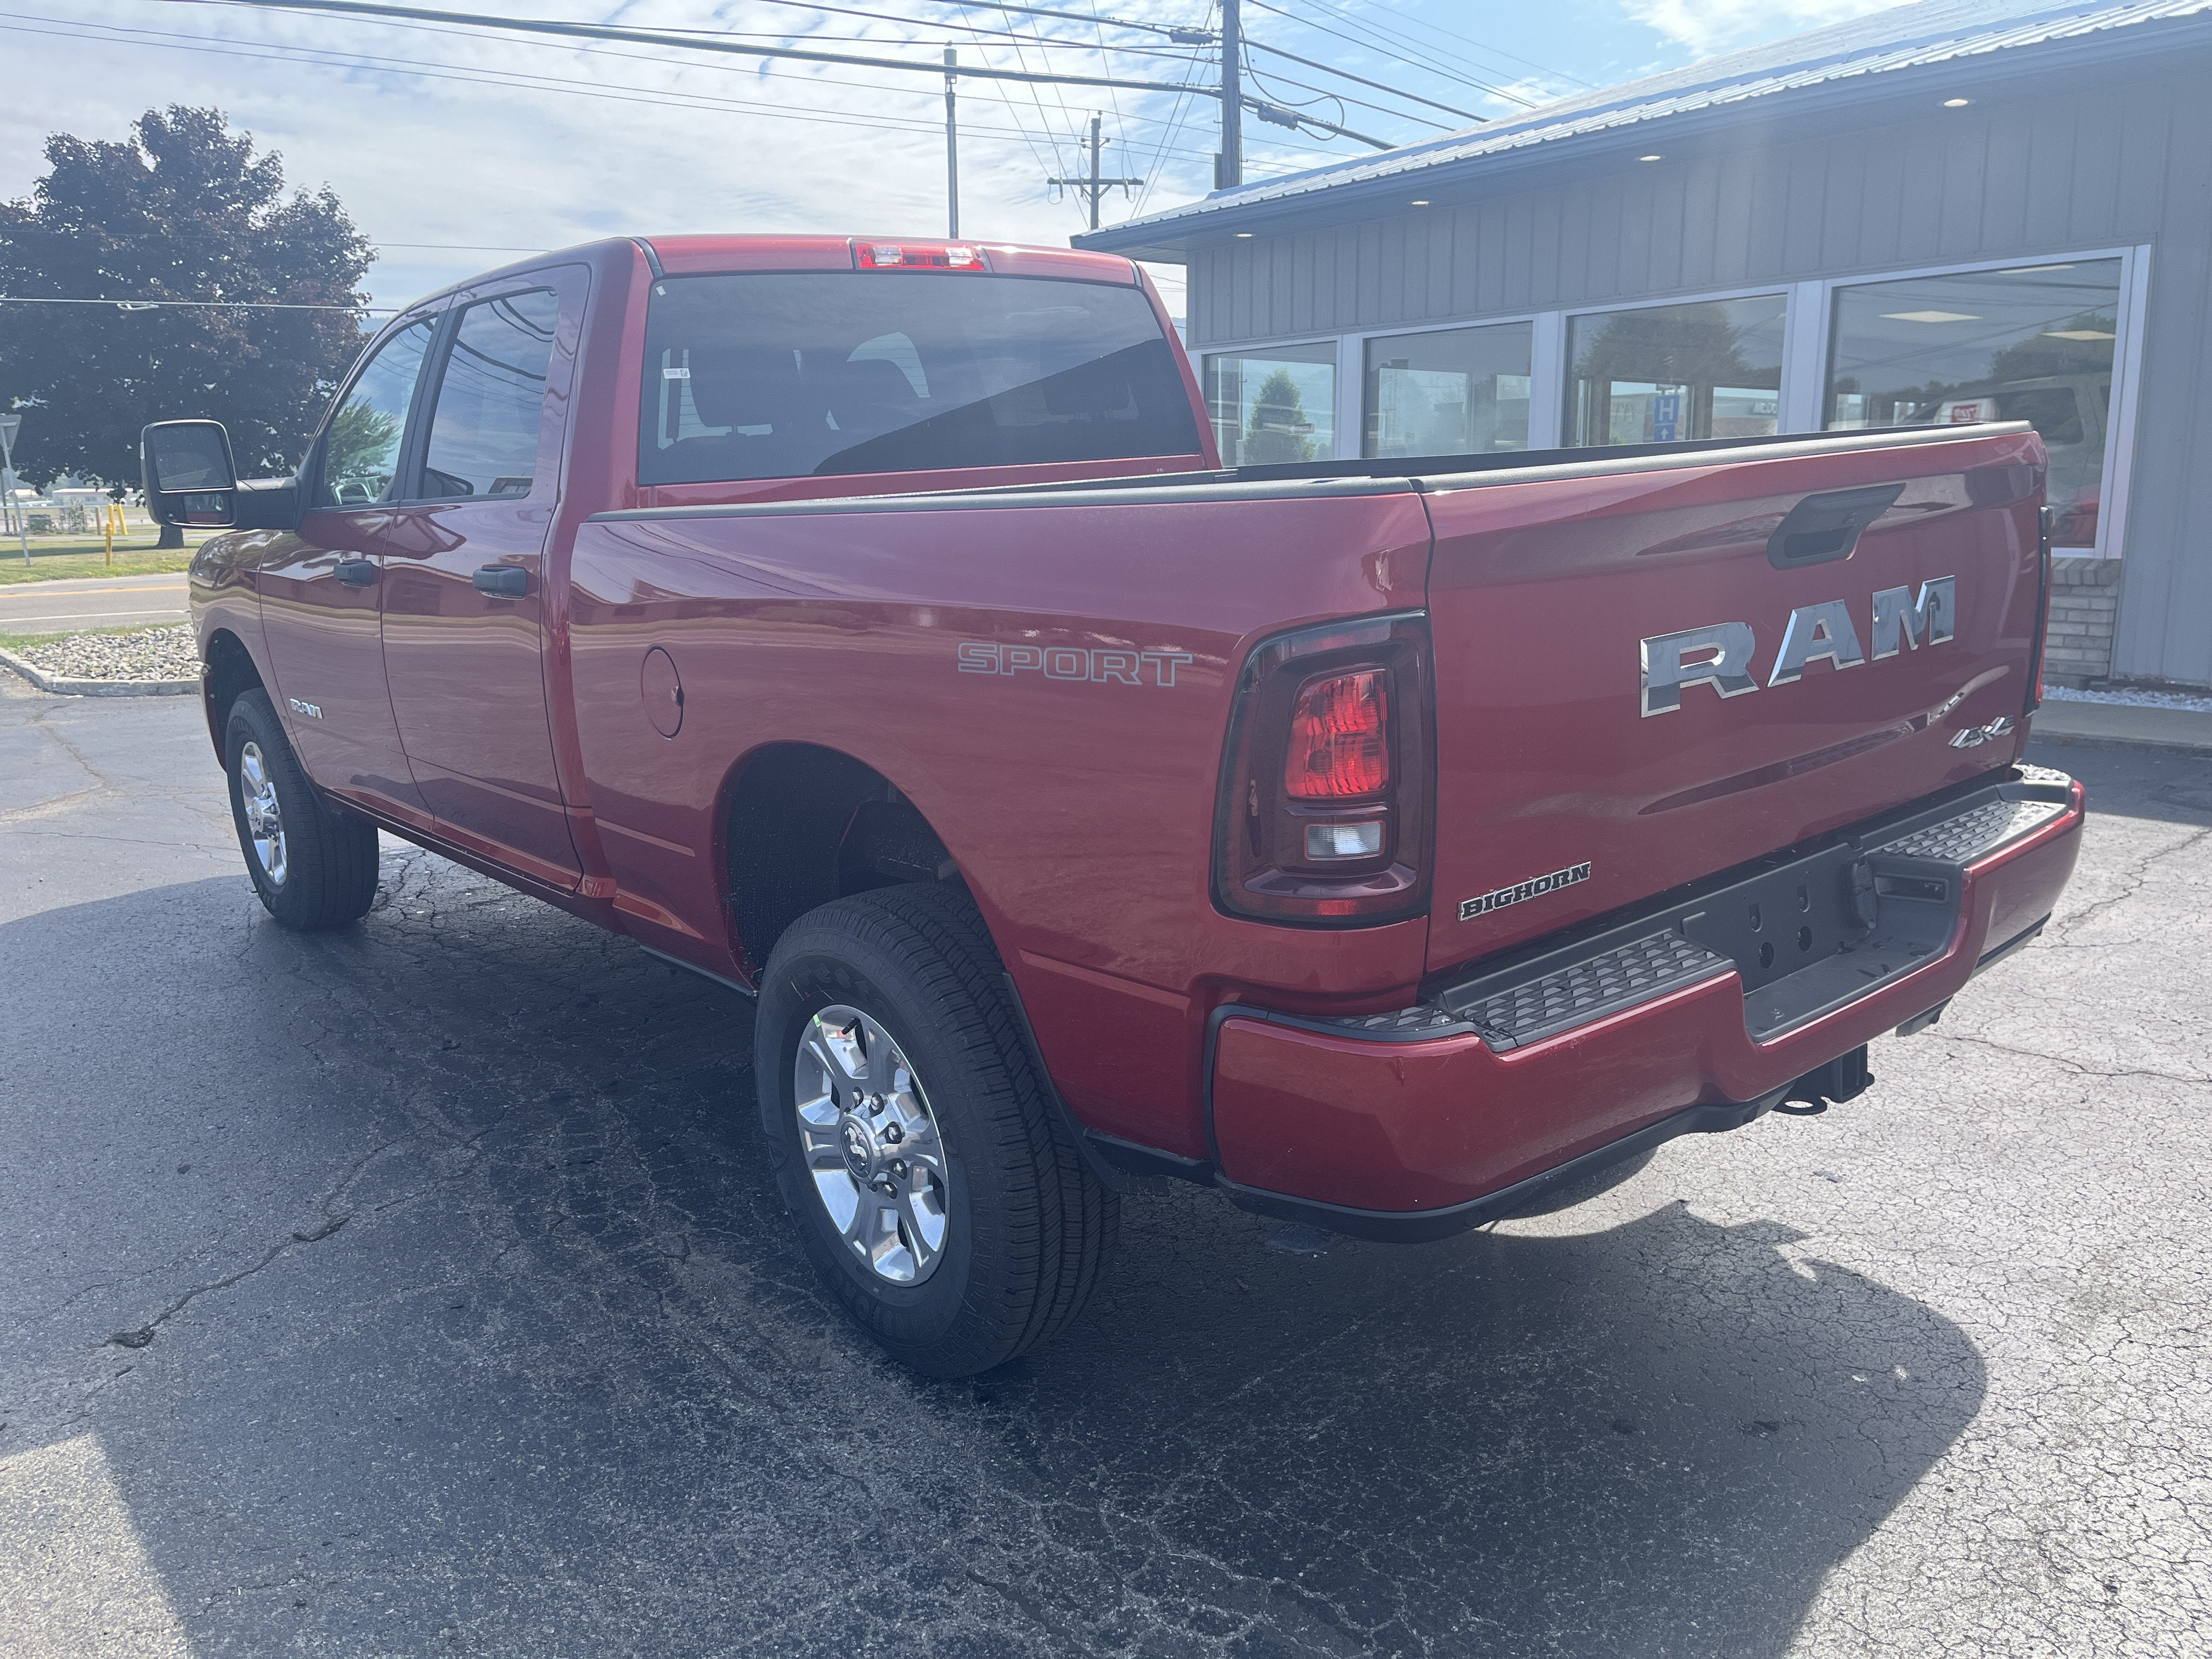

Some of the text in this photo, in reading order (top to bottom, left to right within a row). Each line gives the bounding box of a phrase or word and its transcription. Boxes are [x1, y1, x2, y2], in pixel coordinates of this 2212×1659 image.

[1659, 399, 1674, 421] H
[958, 642, 1193, 687] SPORT
[1640, 575, 1955, 718] RAM
[290, 698, 324, 720] RAM
[1457, 861, 1592, 921] BIGHORN
